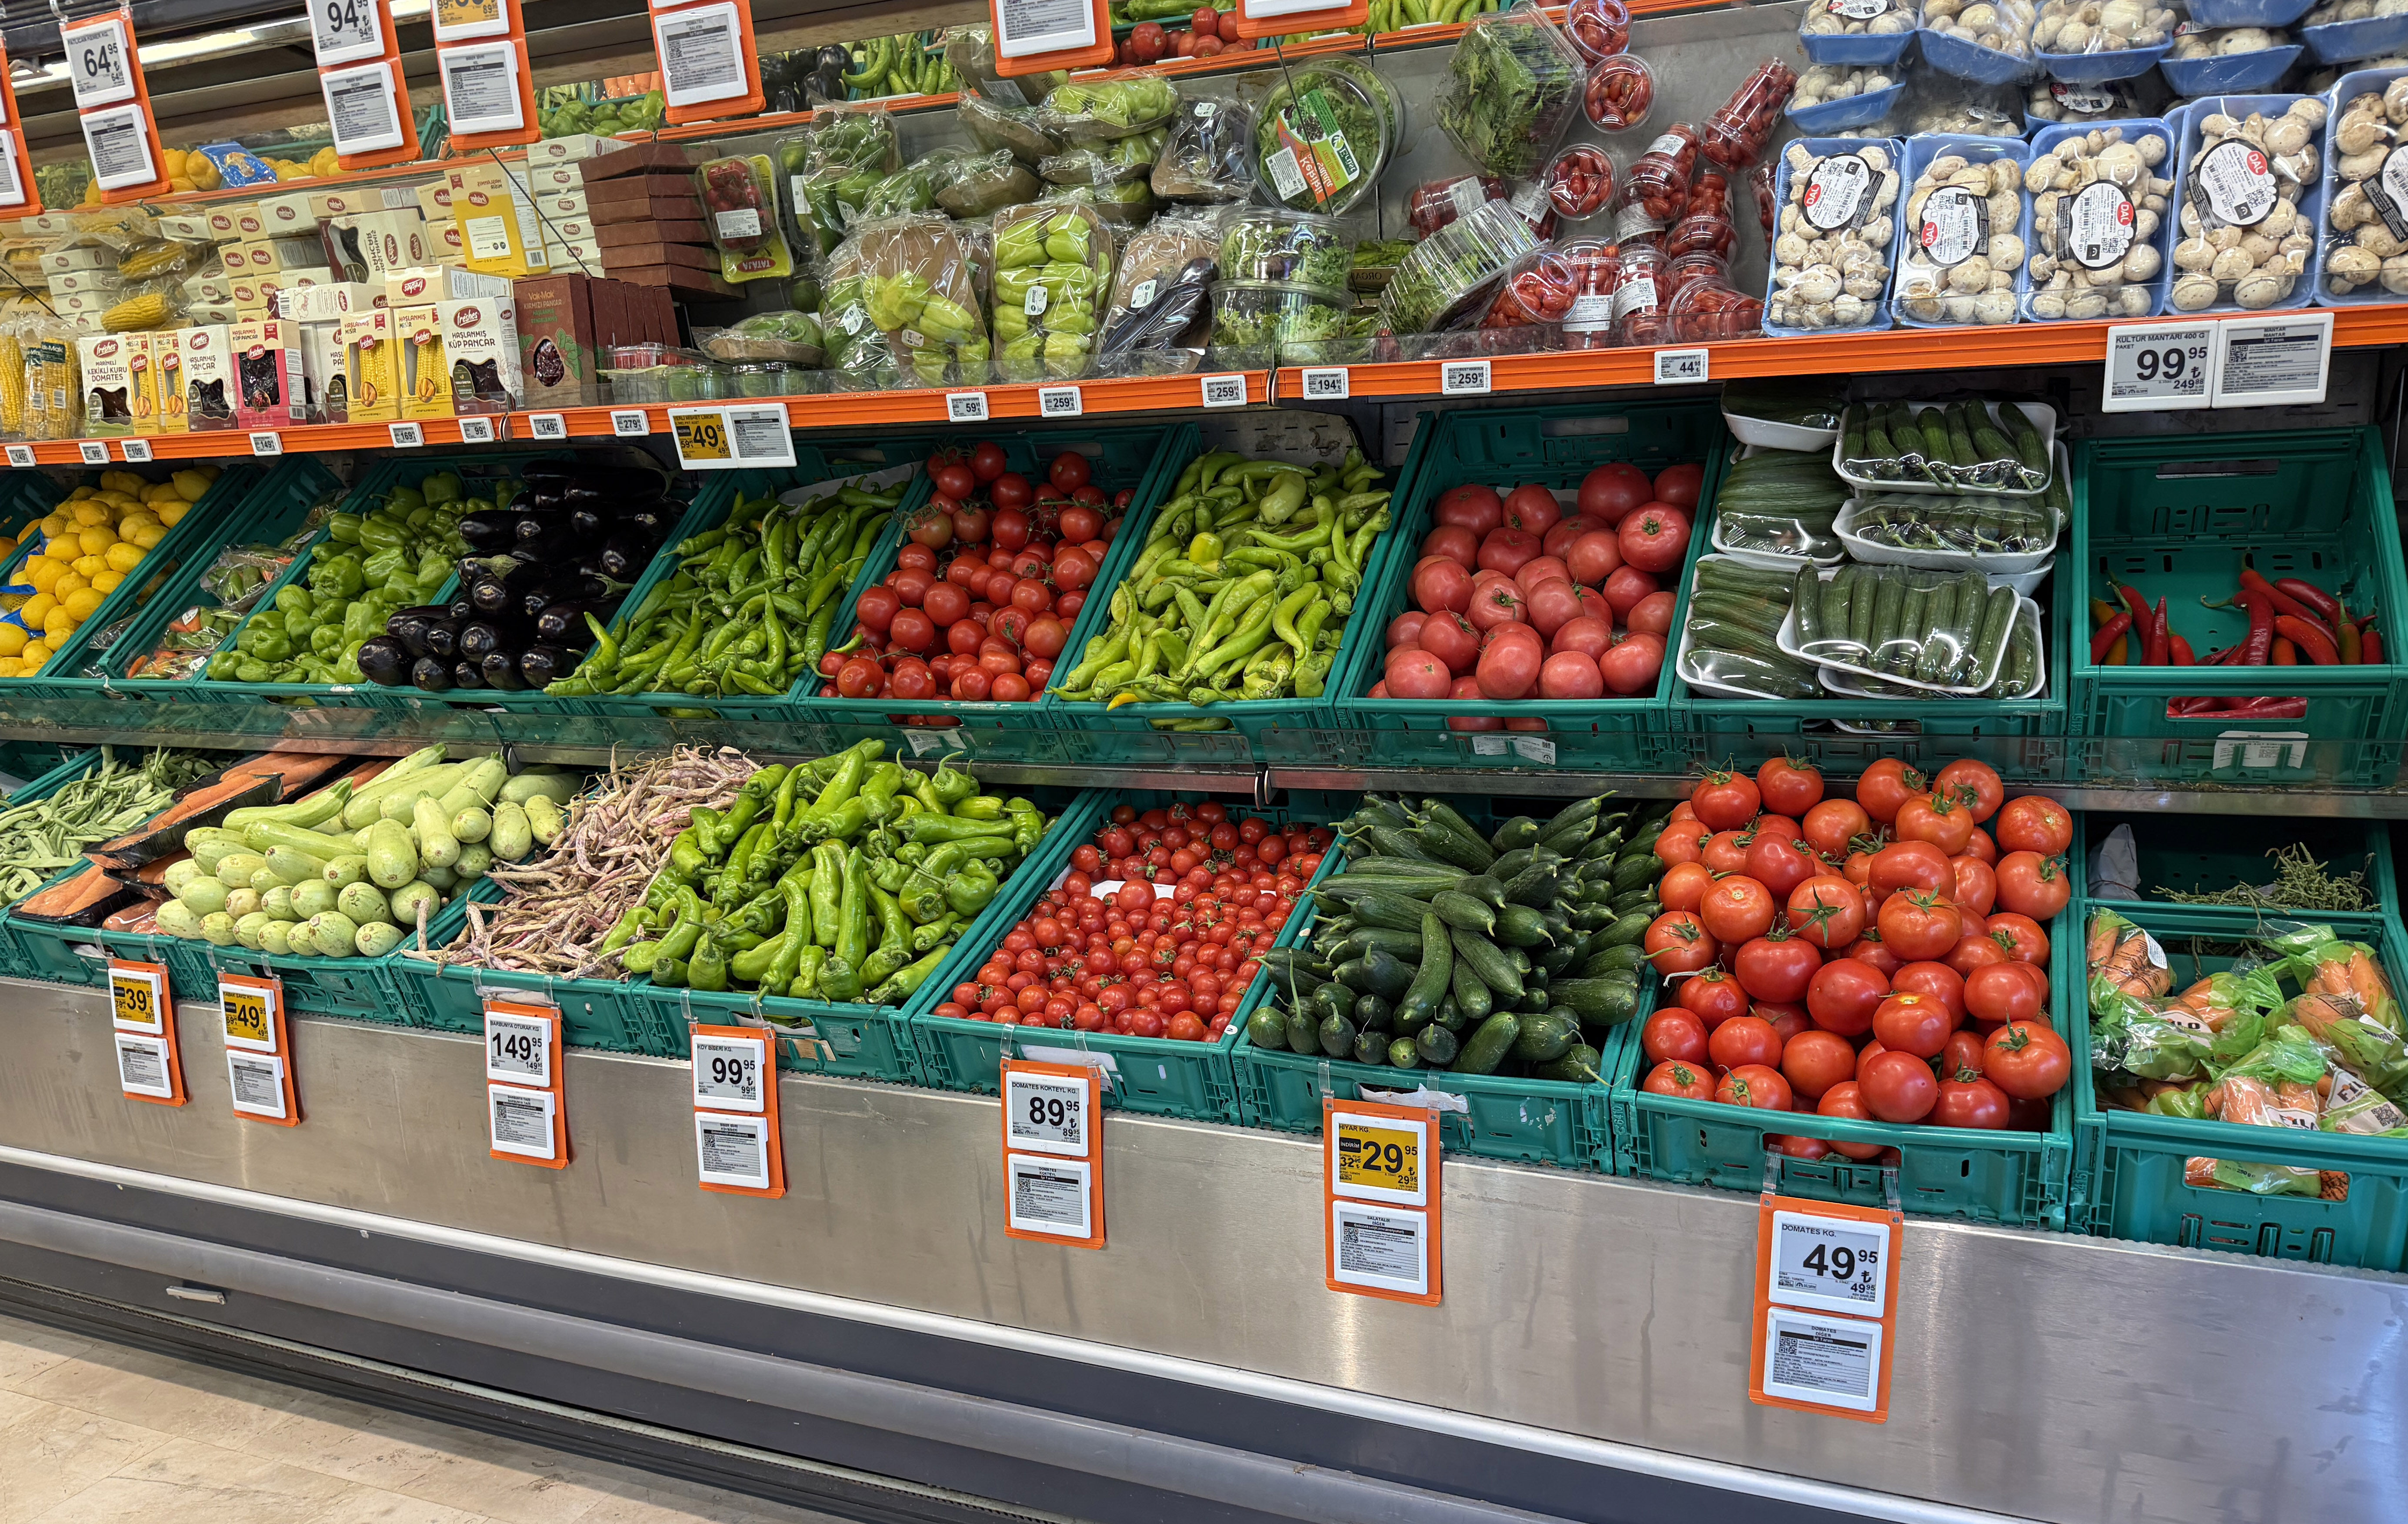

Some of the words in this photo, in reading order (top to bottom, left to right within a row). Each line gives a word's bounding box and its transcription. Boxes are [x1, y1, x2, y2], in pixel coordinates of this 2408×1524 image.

[327, 0, 359, 32] 94
[84, 45, 111, 77] 64
[108, 42, 118, 54] 95
[2248, 153, 2264, 174] DAL
[1806, 186, 1820, 205] DAL
[2120, 204, 2130, 223] DAL
[1925, 224, 1935, 244] DAL
[524, 301, 543, 310] KIRMIZI
[543, 299, 562, 307] PANCAR
[399, 314, 426, 322] HAŞLANMIŞ
[344, 320, 370, 330] HAŞLANMIŞ
[452, 330, 487, 340] HAŞLANMIŞ
[2116, 334, 2146, 343] KÜLTÜR
[448, 339, 462, 349] KÜP
[463, 338, 496, 347] PANCAR
[1679, 361, 1694, 373] 44
[2137, 348, 2186, 381] 99
[2188, 347, 2207, 359] 95
[91, 374, 123, 382] DOMATES
[1458, 373, 1478, 384] 259
[1318, 379, 1337, 390] 194
[2173, 379, 2195, 389] 249
[1216, 386, 1234, 398] 259
[966, 402, 977, 412] 59
[1053, 398, 1070, 408] 259
[541, 423, 555, 432] 149
[624, 419, 638, 429] 279
[400, 431, 413, 440] 169
[474, 426, 484, 435] 99
[693, 425, 718, 448] 49
[260, 440, 272, 448] 149
[681, 440, 690, 448] 59
[131, 447, 142, 456] 109
[126, 988, 147, 1011] 39
[238, 1004, 260, 1029] 49
[492, 1033, 531, 1060] 149
[532, 1037, 542, 1047] 95
[525, 1062, 538, 1070] 149
[712, 1057, 743, 1085] 99
[744, 1059, 755, 1070] 95
[741, 1086, 750, 1094] 99
[1012, 1082, 1039, 1090] DOMATES
[1029, 1096, 1065, 1126] 89
[1066, 1100, 1080, 1112] 95
[1063, 1128, 1074, 1137] 89
[1340, 1156, 1354, 1168] 32
[1362, 1140, 1403, 1173] 29
[1405, 1145, 1418, 1156] 95
[1397, 1175, 1410, 1184] 29
[1782, 1224, 1821, 1235] DOMATES
[1822, 1229, 1836, 1238] KG.
[1803, 1243, 1855, 1280] 49
[1858, 1250, 1878, 1263] 95
[1861, 1270, 1872, 1283] ₺
[1850, 1283, 1866, 1293] 49
